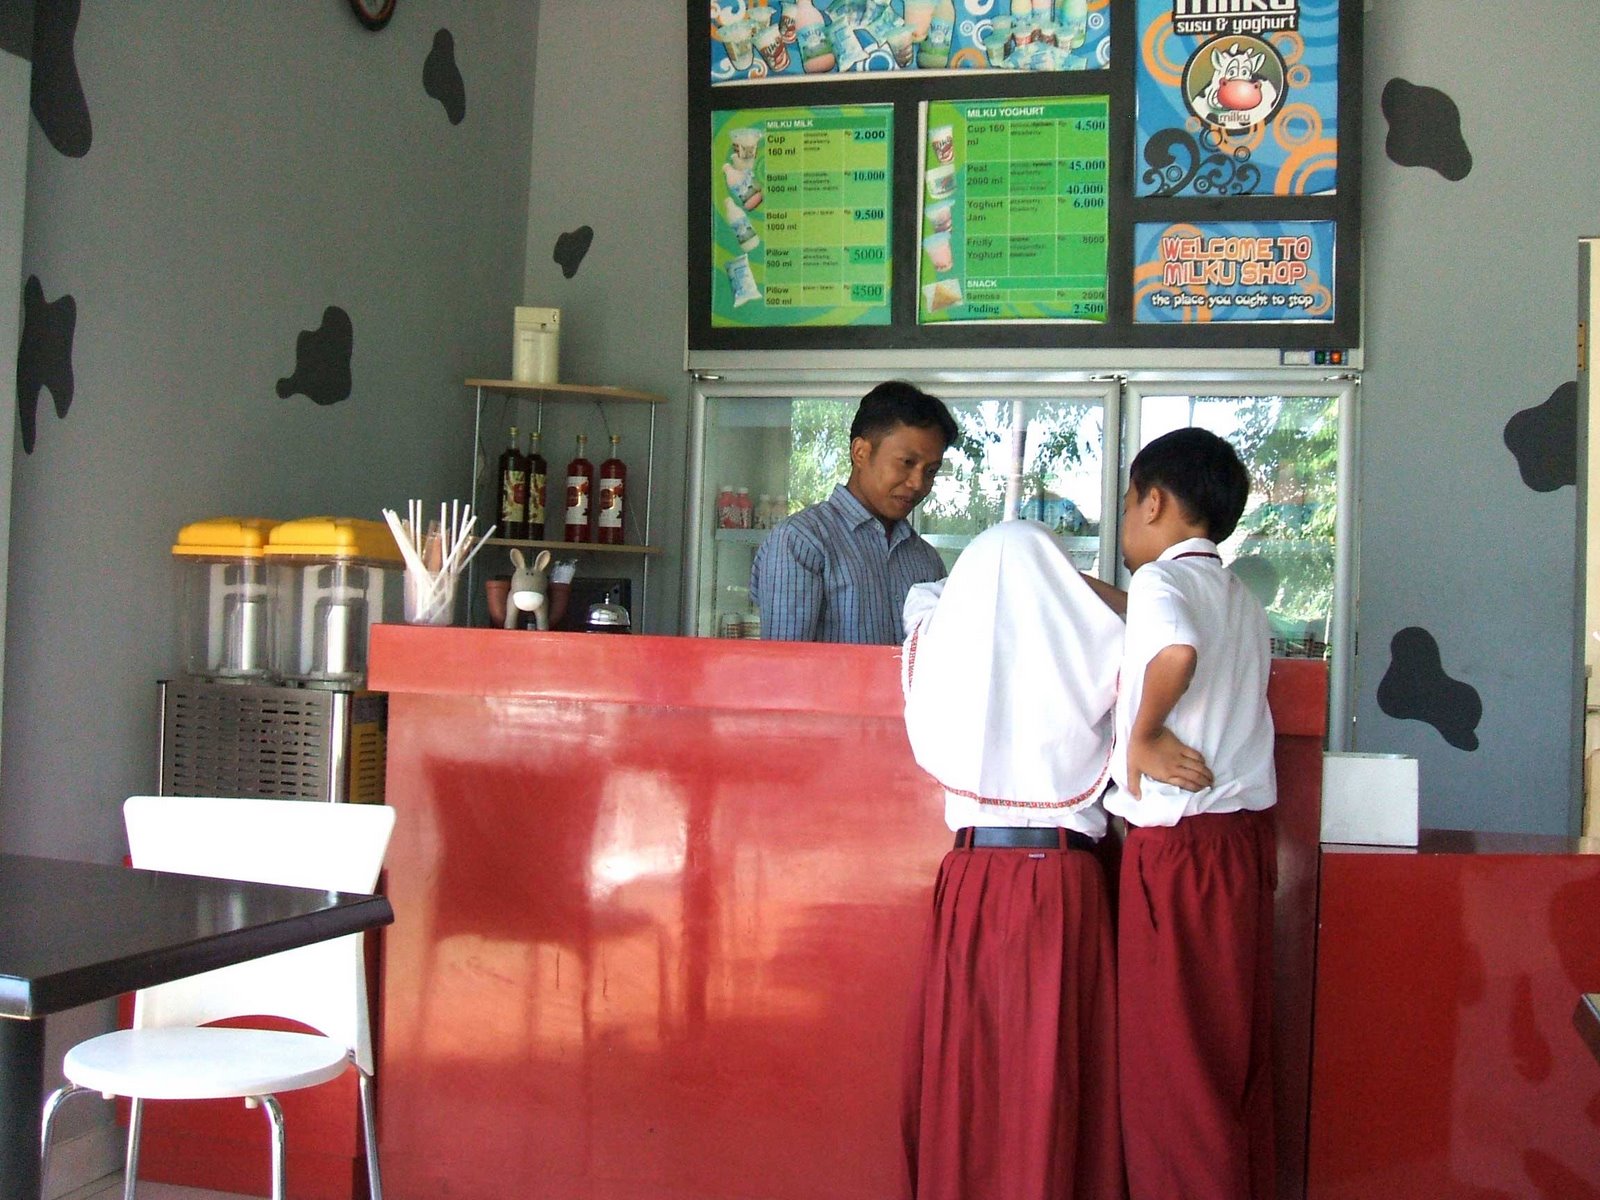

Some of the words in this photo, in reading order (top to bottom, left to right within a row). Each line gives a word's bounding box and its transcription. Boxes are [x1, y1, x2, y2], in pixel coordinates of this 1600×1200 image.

[1176, 20, 1211, 33] susu
[1216, 17, 1228, 31] &
[1232, 14, 1295, 34] yoghurt
[967, 108, 997, 118] MILKU
[1000, 106, 1045, 117] YOGHURT
[1219, 112, 1250, 122] milku
[766, 120, 793, 129] MILKU
[794, 119, 814, 128] MILK
[1075, 120, 1105, 130] 4.500
[967, 125, 986, 134] Cup
[767, 135, 786, 144] Cup
[854, 130, 885, 140] 2.000
[967, 138, 979, 146] ml
[768, 148, 783, 156] 160
[785, 147, 796, 155] ml
[1069, 161, 1106, 170] 45.000
[853, 171, 885, 181] 10.000
[767, 185, 785, 193] 1000
[1066, 184, 1104, 195] 40.000
[967, 200, 1003, 211] Yoghurt
[1073, 198, 1104, 208] 6.000
[855, 209, 884, 220] 9.500
[767, 223, 785, 231] 1000
[766, 248, 789, 257] Pillow
[1162, 236, 1274, 261] WELCOME
[1277, 236, 1312, 260] TO
[854, 249, 883, 261] 5000
[967, 250, 1003, 261] Yoghurt
[766, 260, 780, 268] 500
[1163, 259, 1236, 286] MILKU
[1241, 260, 1307, 285] SHOP
[967, 279, 997, 288] SNACK
[852, 286, 882, 297] 4500
[1152, 292, 1170, 306] the
[1173, 293, 1205, 309] place
[1208, 295, 1231, 309] you
[1235, 292, 1268, 309] ought
[1272, 294, 1285, 305] to
[1288, 294, 1314, 309] stop
[968, 304, 1000, 314] Puding
[1074, 303, 1104, 314] 2.500
